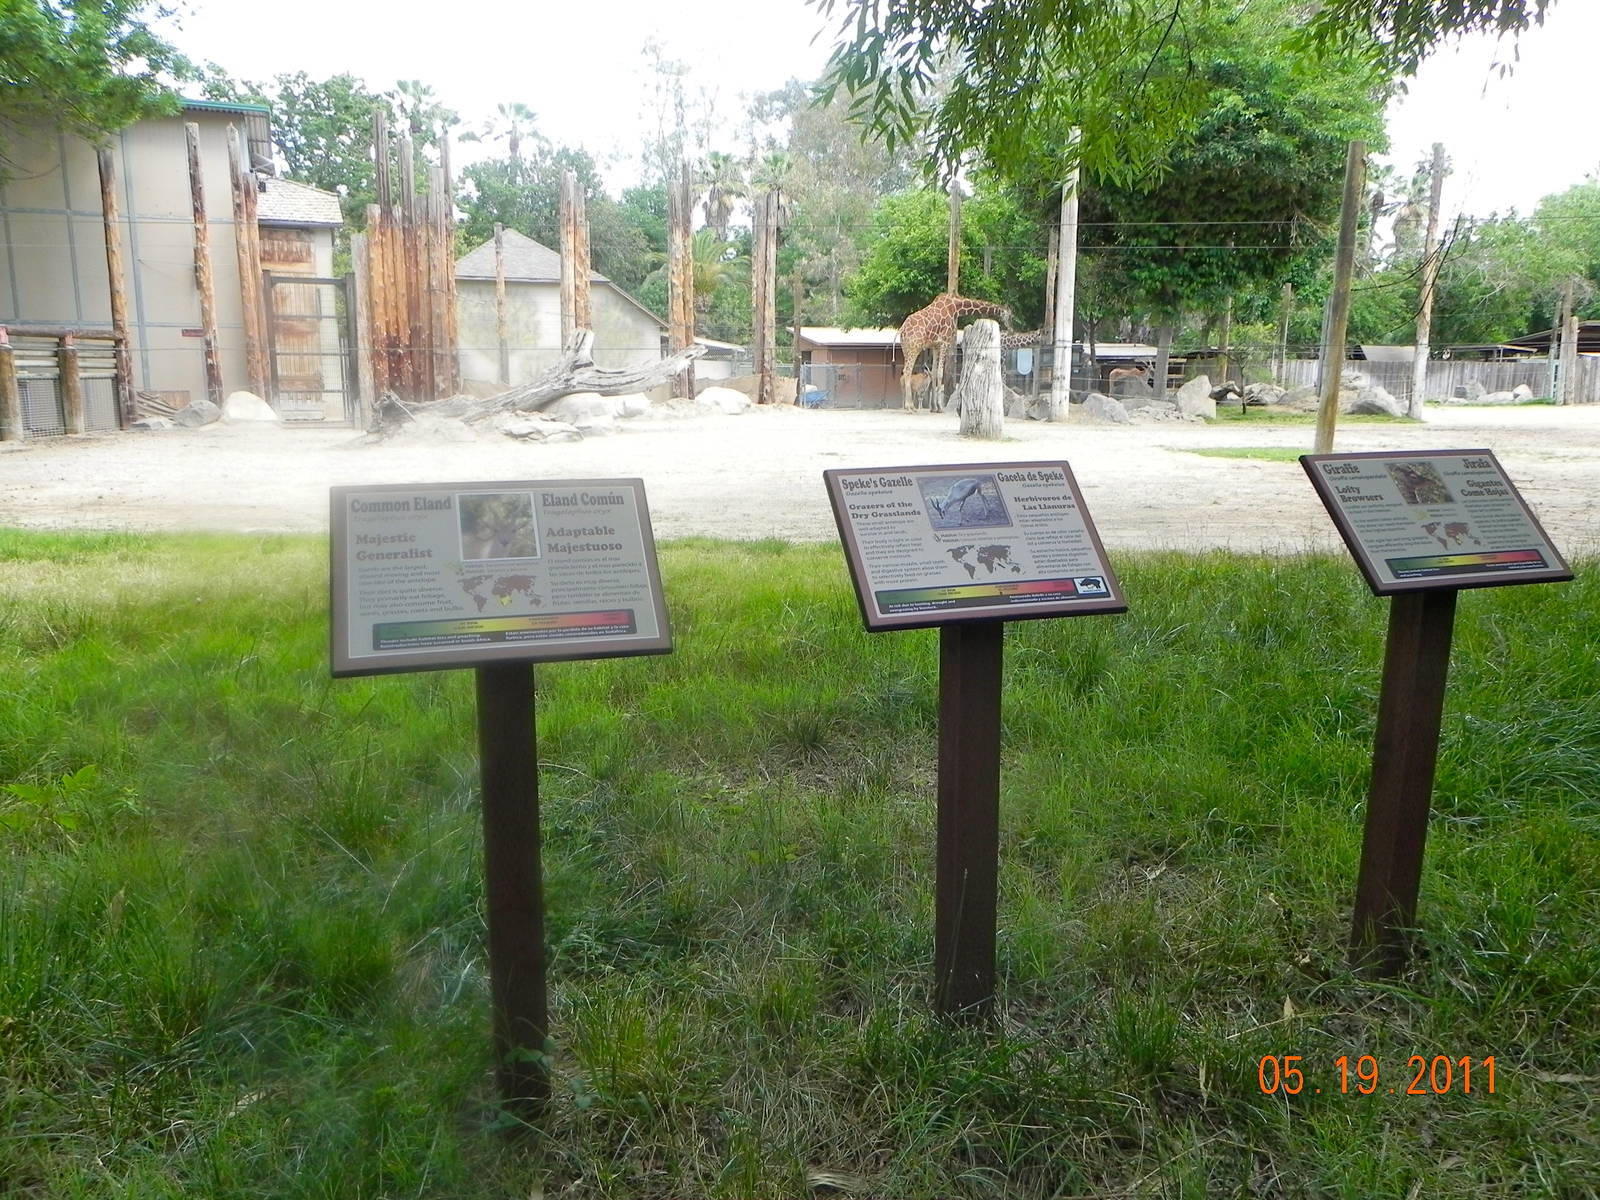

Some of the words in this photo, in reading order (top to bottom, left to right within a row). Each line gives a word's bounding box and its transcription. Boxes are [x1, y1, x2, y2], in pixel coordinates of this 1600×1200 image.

[1323, 464, 1360, 474] Giraffe
[997, 472, 1026, 483] Gacela
[1027, 472, 1037, 481] de
[1038, 471, 1064, 483] Speke
[842, 478, 878, 491] Speke's
[879, 476, 913, 487] Gazelle
[1335, 486, 1360, 494] Lofty
[351, 499, 410, 512] Common
[414, 496, 452, 511] Eland
[542, 493, 578, 506] Eland
[581, 491, 624, 505] Común
[546, 526, 616, 538] Adaptable
[356, 533, 416, 546] Majestic
[356, 548, 432, 560] Generalist
[547, 542, 622, 554] Majestuoso
